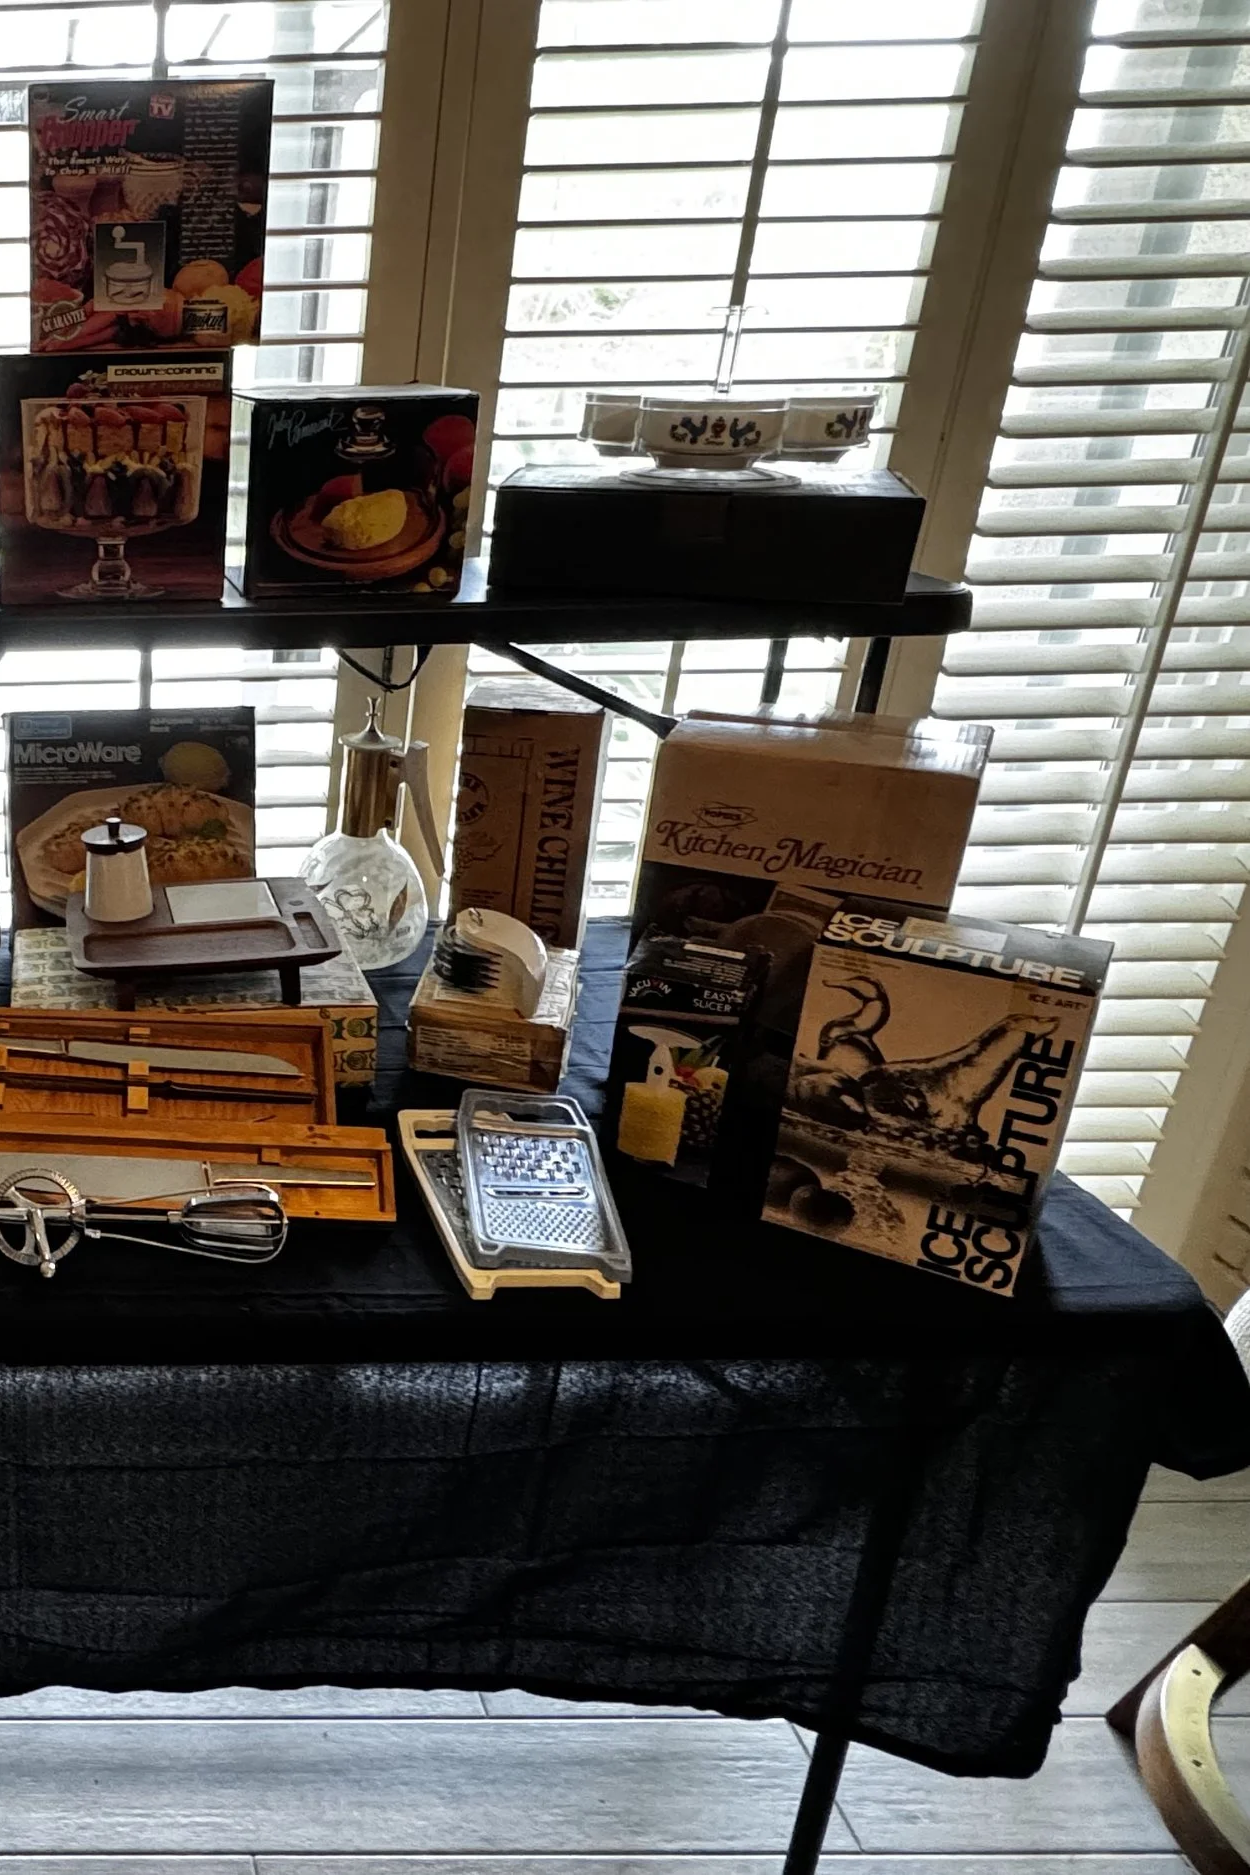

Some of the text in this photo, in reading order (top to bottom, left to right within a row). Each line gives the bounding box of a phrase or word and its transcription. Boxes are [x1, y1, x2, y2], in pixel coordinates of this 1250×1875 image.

[57, 96, 131, 124] Smart
[152, 102, 171, 116] TV
[105, 156, 128, 165] Way
[114, 366, 217, 376] CROWN CORNING
[13, 741, 143, 764] MicroWare
[540, 744, 581, 830] WINE
[655, 819, 924, 887] Kitchen Magician
[830, 910, 900, 935] ICE
[823, 922, 1087, 990] SCULPTURE
[628, 978, 674, 999] VACUVIN
[703, 989, 734, 1004] EASY
[1028, 992, 1053, 1005] ICE
[692, 998, 733, 1013] SLICER
[963, 1031, 1077, 1290] SCULPTURE
[916, 1203, 976, 1279] ICE
